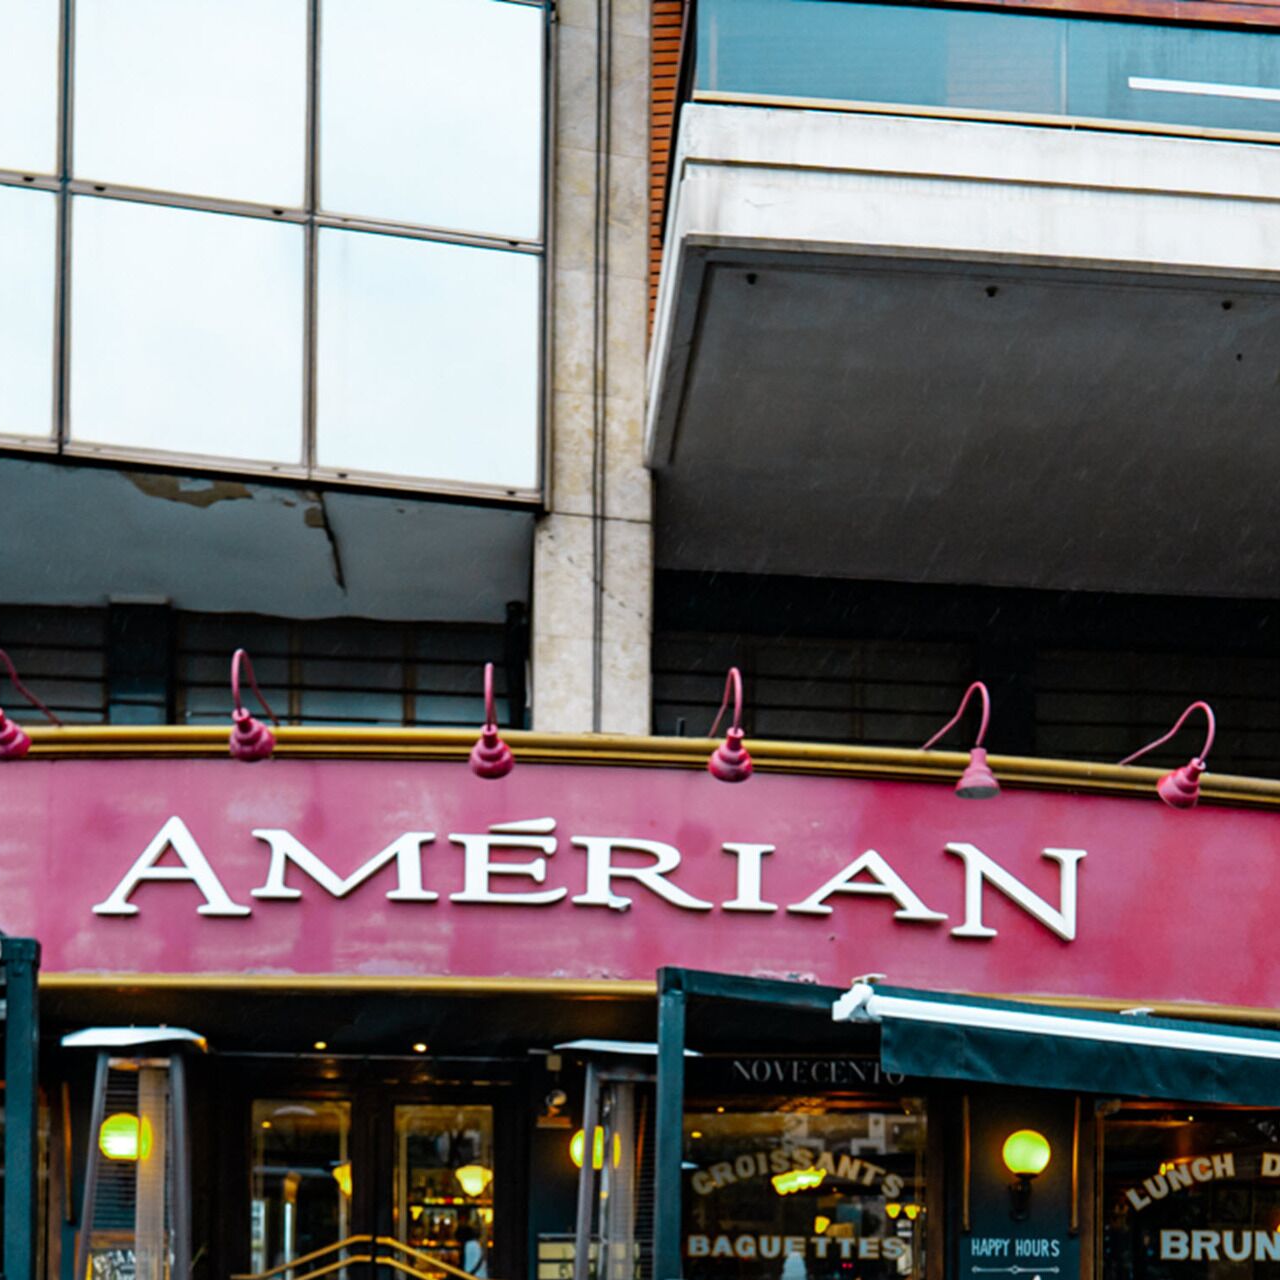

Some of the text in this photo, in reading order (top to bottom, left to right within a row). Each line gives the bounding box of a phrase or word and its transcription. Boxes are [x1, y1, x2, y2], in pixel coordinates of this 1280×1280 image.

[91, 815, 1088, 941] AMÉRIAN
[691, 1148, 905, 1198] CROISSANTS
[1125, 1152, 1236, 1212] LUNCH
[687, 1235, 906, 1260] BAGUETTES
[971, 1237, 1061, 1258] HAPPY HOURS
